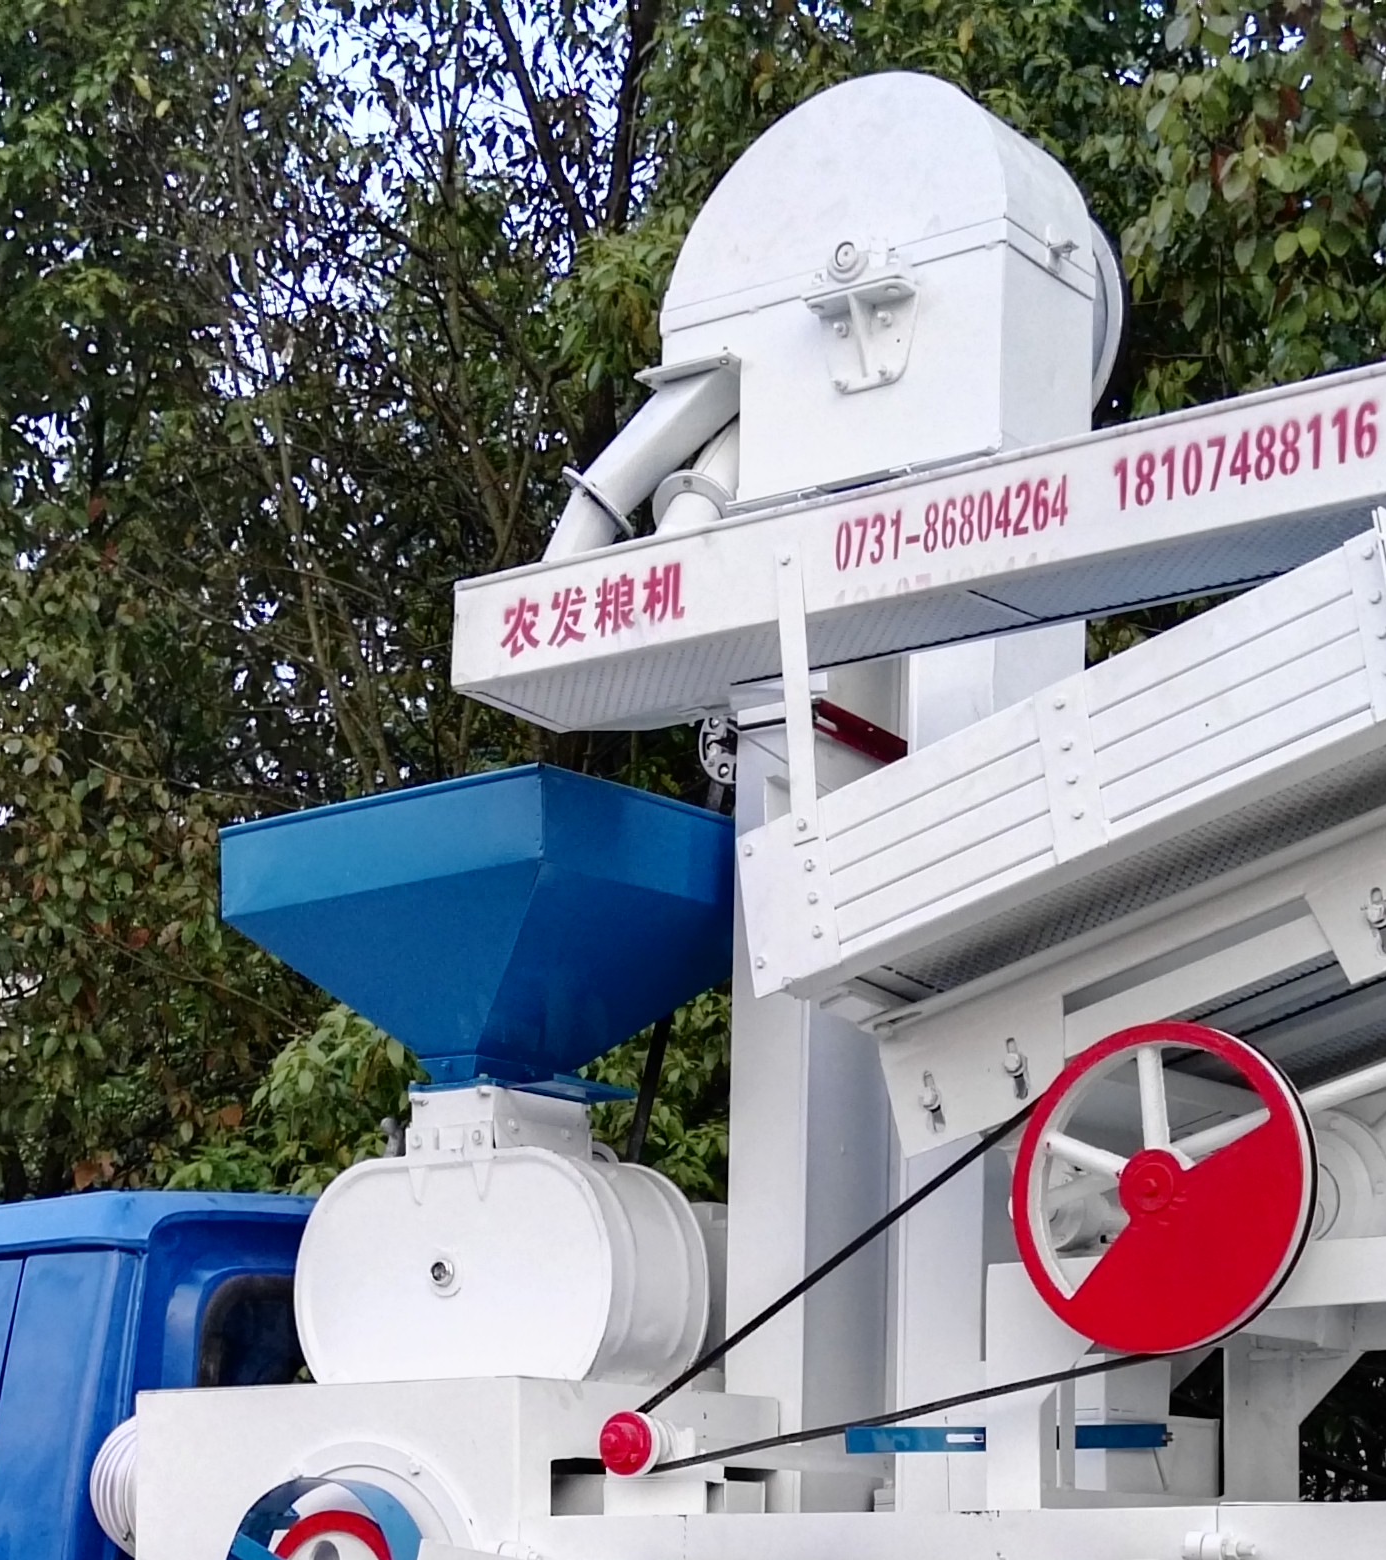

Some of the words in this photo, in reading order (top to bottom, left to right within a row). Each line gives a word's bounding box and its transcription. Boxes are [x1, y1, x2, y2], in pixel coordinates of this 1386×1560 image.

[500, 562, 685, 659] 农发粮机
[835, 474, 1068, 572] 0731-86804264
[1113, 400, 1379, 511] 18107488116
